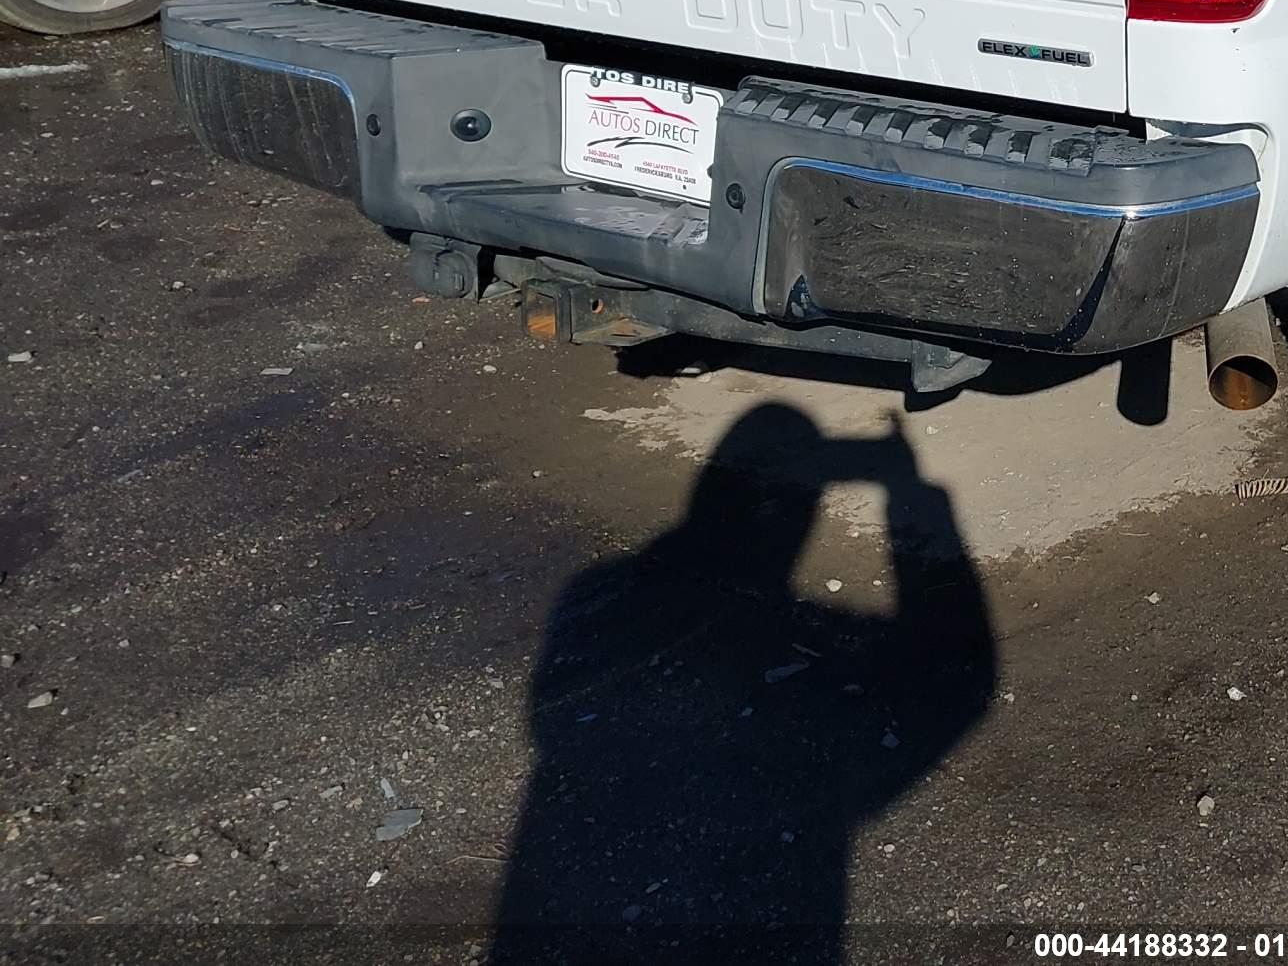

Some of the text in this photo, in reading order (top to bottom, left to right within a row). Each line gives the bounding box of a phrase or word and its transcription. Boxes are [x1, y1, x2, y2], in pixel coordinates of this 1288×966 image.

[982, 41, 1088, 65] FLEX FUEL
[588, 109, 700, 145] AUTOS DIRECT
